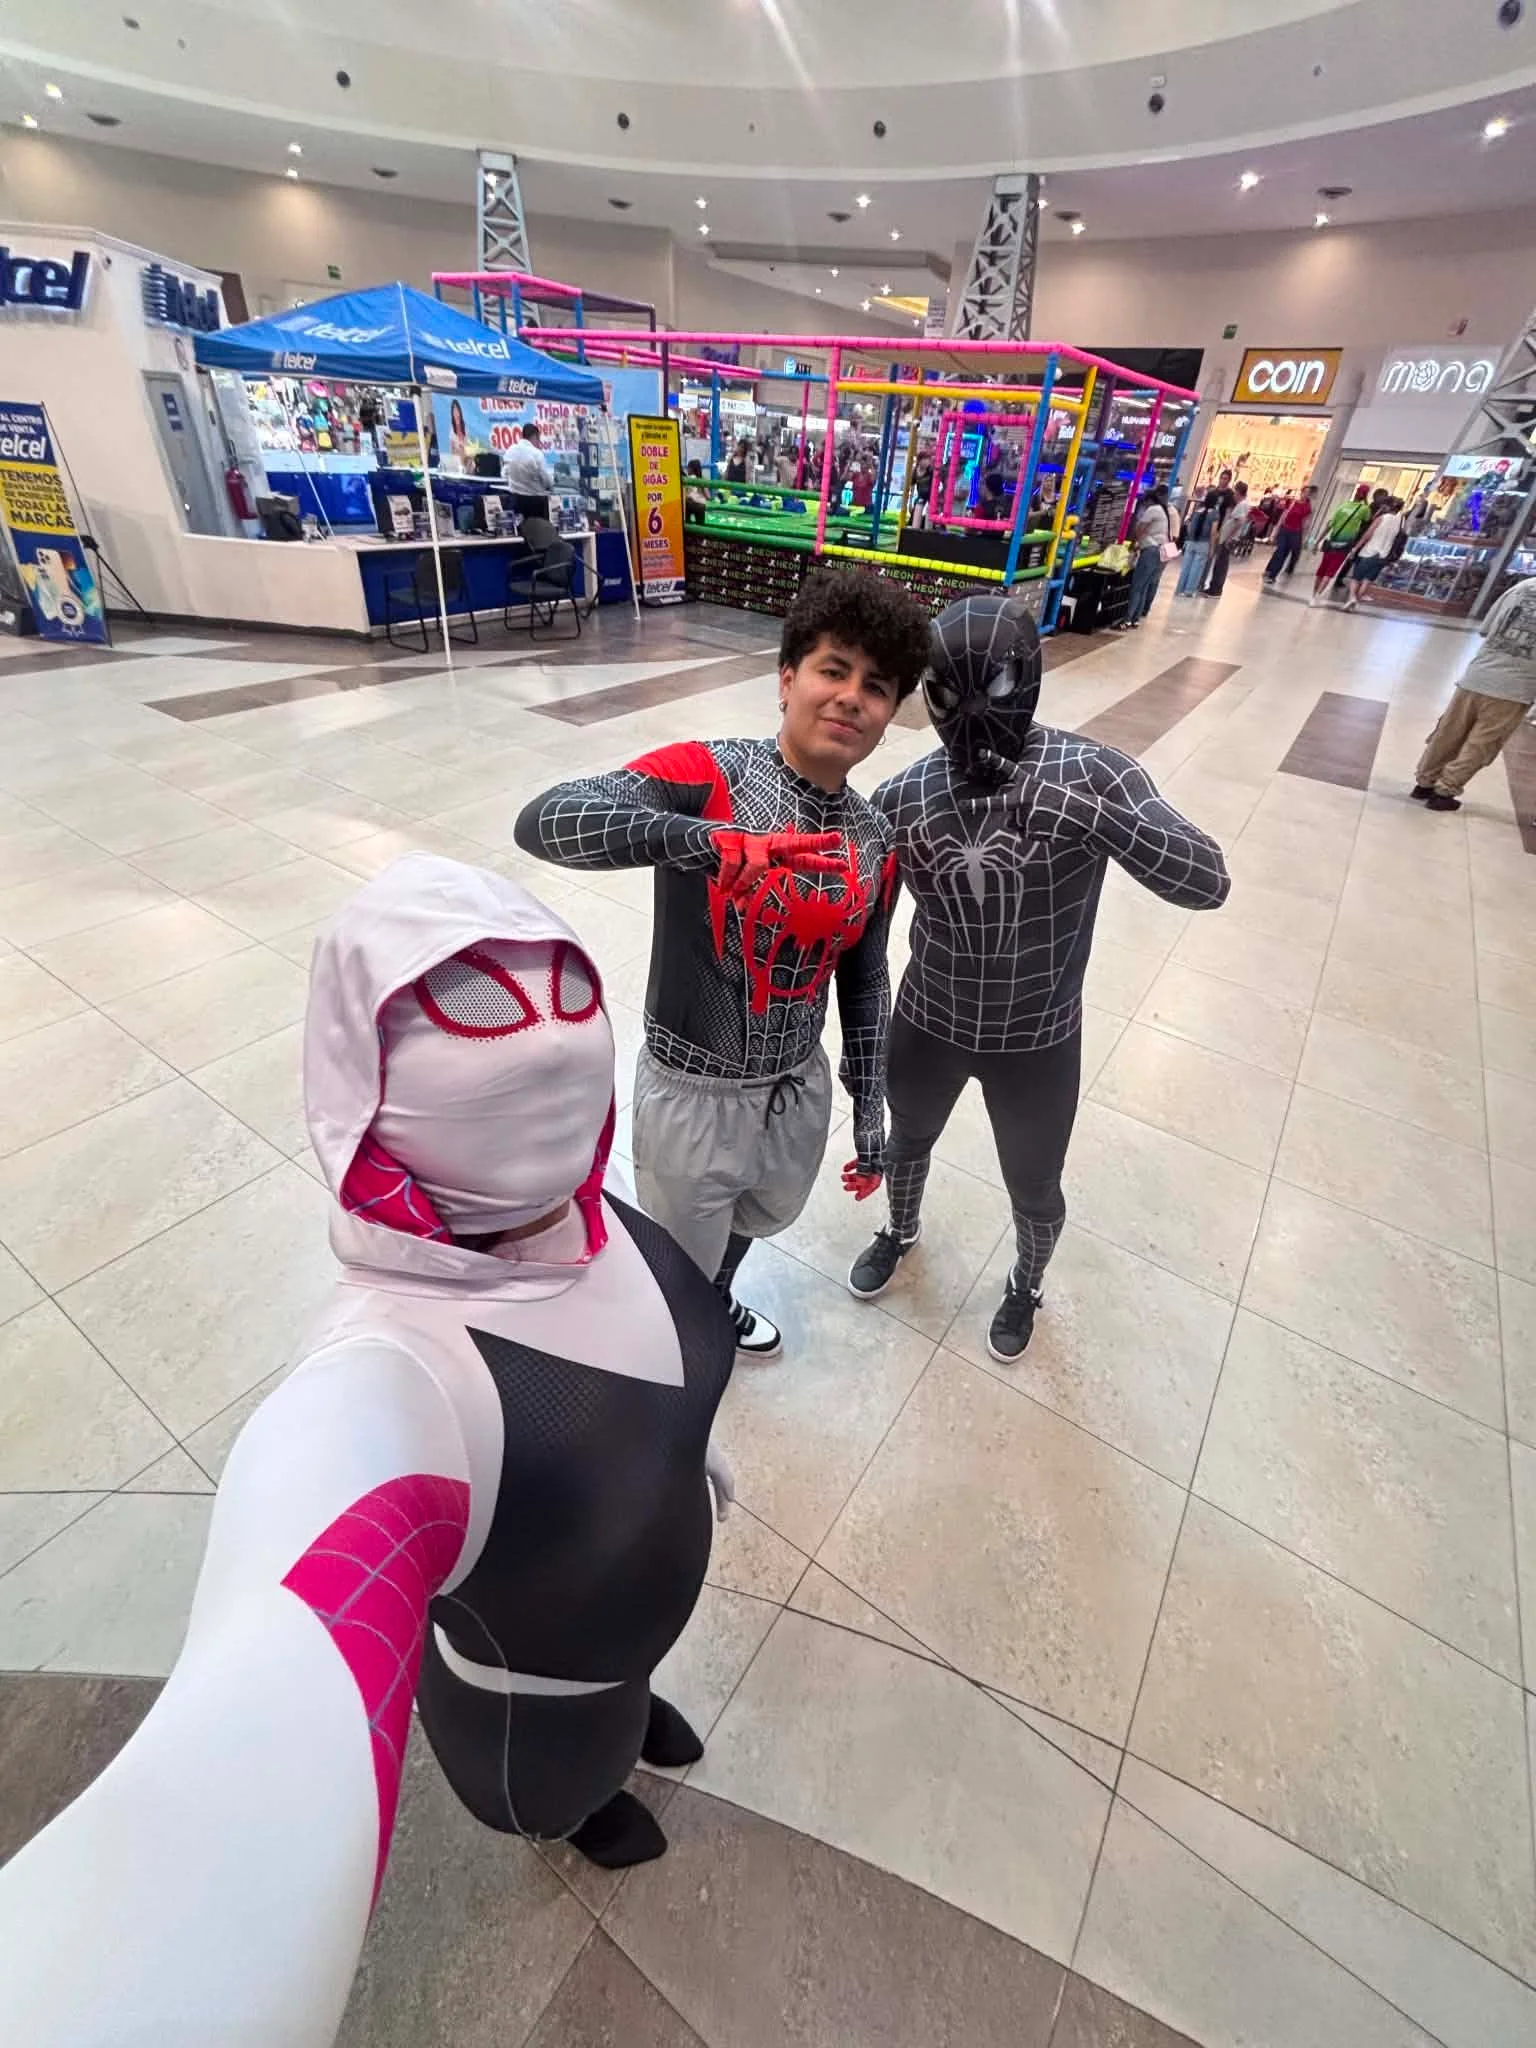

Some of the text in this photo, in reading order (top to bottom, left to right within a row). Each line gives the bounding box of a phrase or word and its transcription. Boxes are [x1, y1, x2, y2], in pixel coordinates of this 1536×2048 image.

[445, 338, 511, 359] telcel
[283, 352, 317, 369] telcel
[1248, 359, 1325, 394] coin
[508, 379, 538, 396] telcel
[0, 434, 46, 459] elcel
[641, 446, 669, 457] DOBLE
[0, 469, 63, 486] TENEMOS
[643, 475, 668, 485] GIGAS
[648, 493, 662, 502] POR
[10, 511, 75, 529] MARCAS
[648, 507, 663, 534] 6
[644, 540, 669, 549] MESES
[886, 568, 914, 580] NEON
[913, 584, 942, 595] NEON
